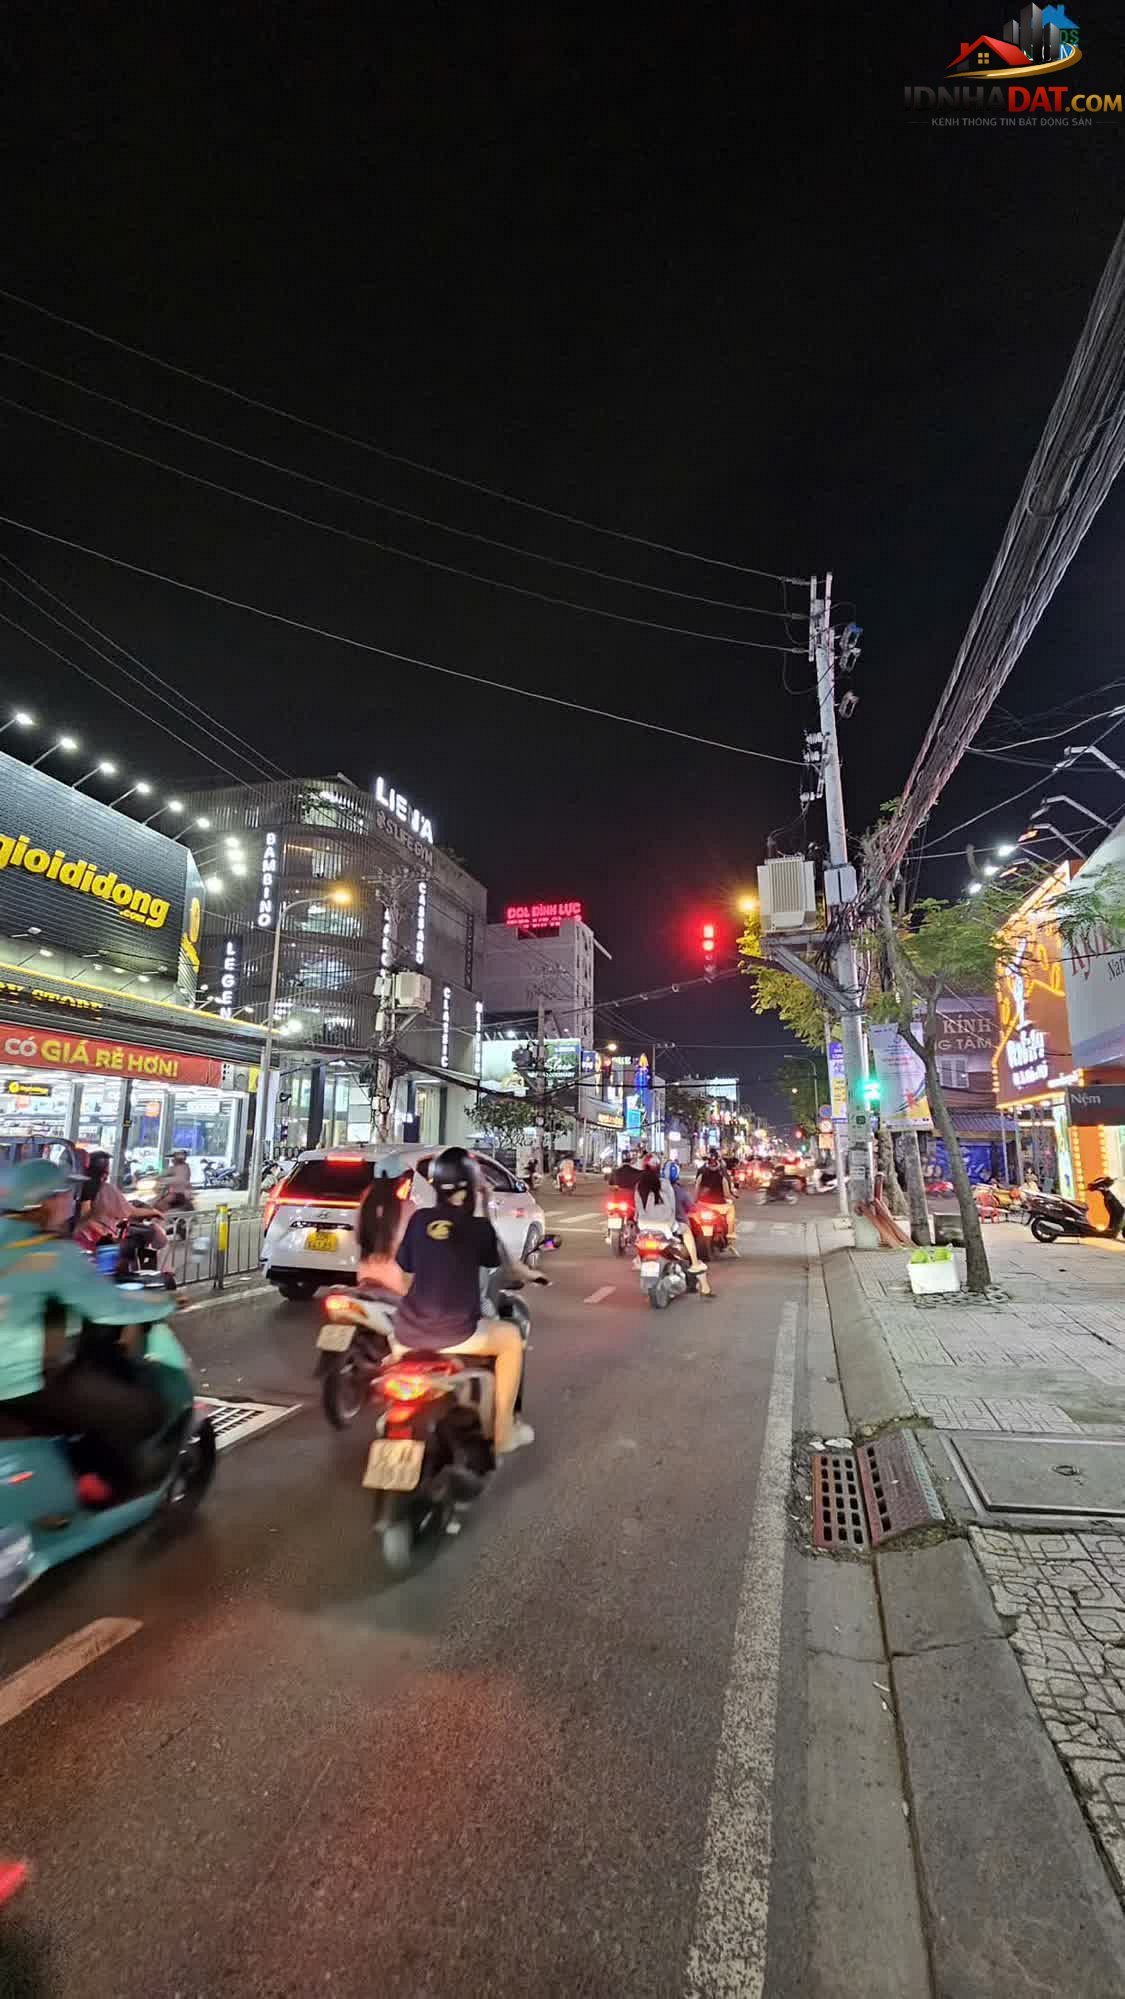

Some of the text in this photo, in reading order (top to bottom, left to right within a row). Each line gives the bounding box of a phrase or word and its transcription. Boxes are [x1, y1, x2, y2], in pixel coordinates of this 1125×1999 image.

[258, 832, 276, 927] BAMBINO
[5, 1036, 180, 1078] CÓ GIÁ RẺ HƠN!
[1071, 1092, 1101, 1107] Nệm
